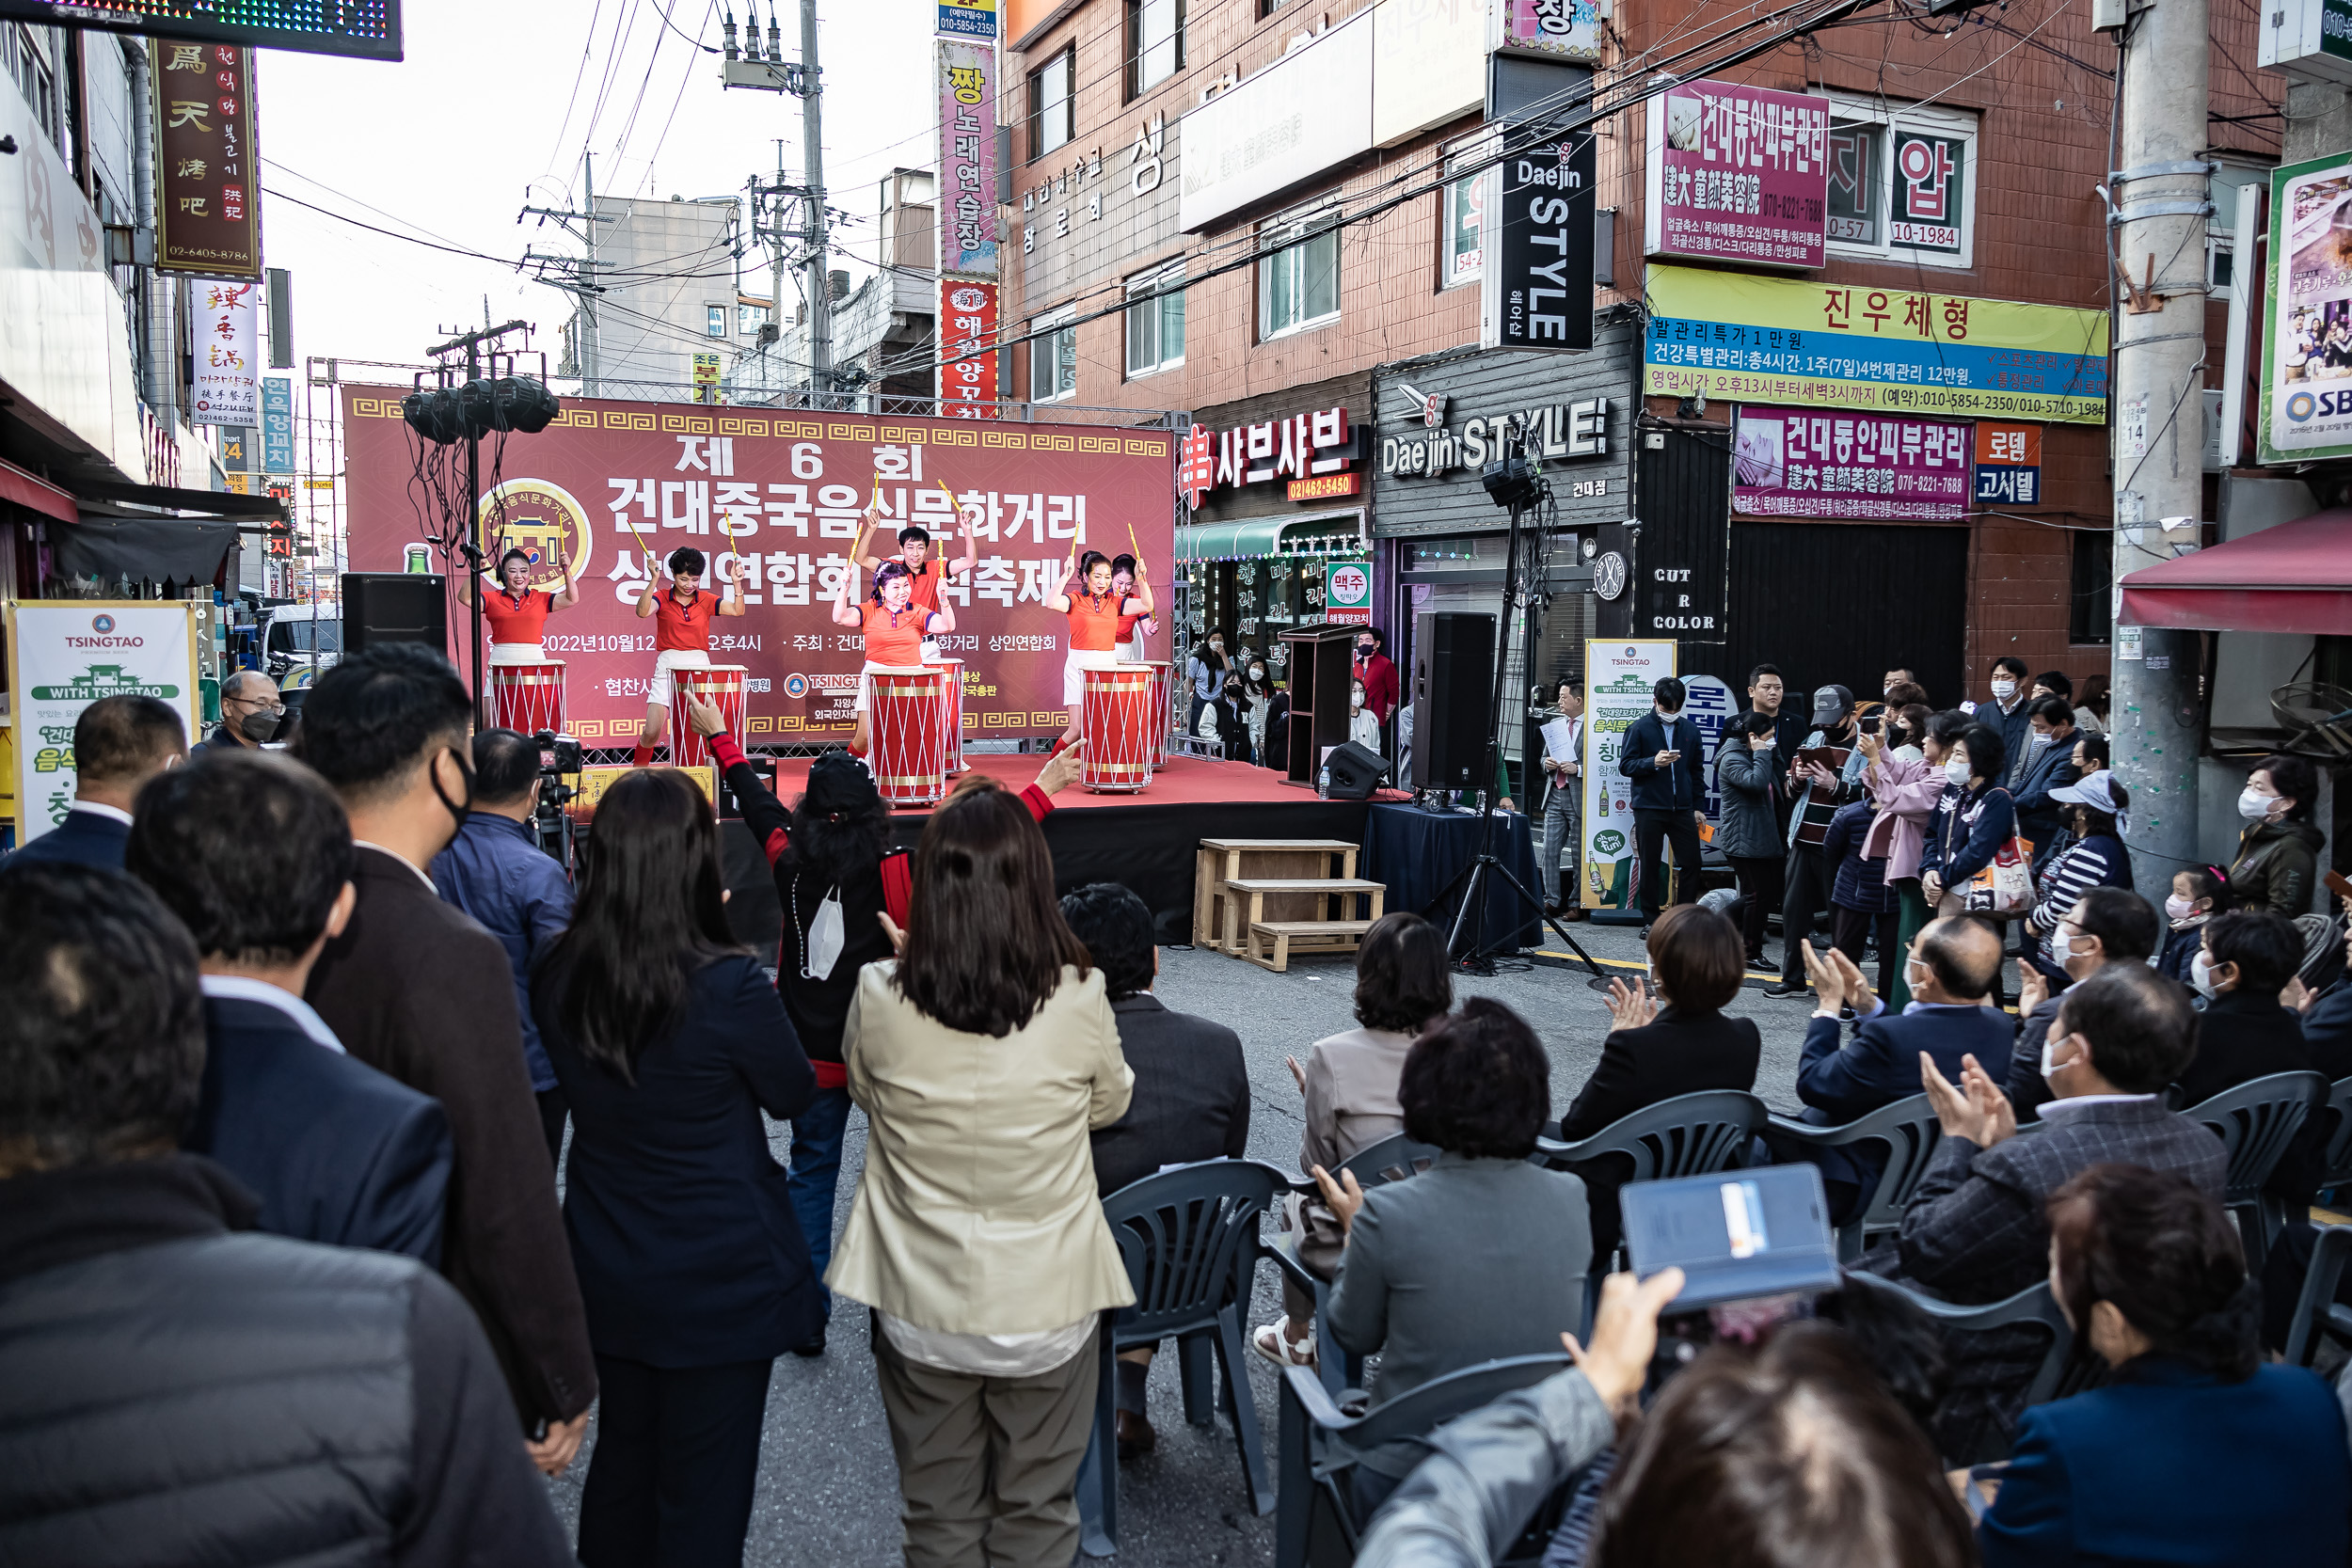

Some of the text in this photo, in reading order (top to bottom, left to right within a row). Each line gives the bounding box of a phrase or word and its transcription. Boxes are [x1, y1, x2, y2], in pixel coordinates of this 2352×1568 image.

[949, 8, 986, 21] (예약필수)
[941, 18, 994, 34] 010-5854-2350
[1704, 94, 1825, 177] 건대동안피부관리
[1518, 160, 1581, 190] Daejin
[1764, 193, 1822, 223] 070-8221-7688
[169, 245, 248, 261] 02-6405-8786
[1530, 197, 1568, 340] STYLE
[1510, 290, 1522, 337] 헤어샵
[1823, 290, 1969, 341] 진우체형
[1998, 353, 2058, 371] 스포츠관리
[1652, 370, 1709, 391] 영업시간
[199, 414, 254, 423] 02)462-5358
[2128, 424, 2143, 440] 14
[1216, 407, 1345, 488] 샤브샤브
[1788, 417, 1964, 468] 건대동안피부관리
[1988, 432, 2026, 462] 로뎀
[675, 436, 923, 483] 제 6 회
[1382, 430, 1457, 477] Daejin
[1573, 480, 1607, 499] 건대점
[1898, 473, 1963, 494] 070-8221-7688
[1978, 470, 2033, 502] 고시텔
[608, 478, 1086, 545] 건대중국음식문화거리
[1335, 575, 1363, 591] 맥주
[1655, 568, 1691, 582] CUT
[1270, 561, 1291, 666] 마라탕
[1329, 613, 1369, 624] 해월양꼬치
[1653, 616, 1714, 629] COLOR
[66, 636, 144, 647] TSINGTAO
[542, 634, 657, 653] 2022년10월12
[988, 635, 1057, 652] 상인연합회
[50, 688, 89, 699] WITH
[38, 710, 62, 719] 맛있는
[1595, 720, 1634, 733] 음식문
[1597, 834, 1619, 843] oh my
[1601, 841, 1622, 852] fun!
